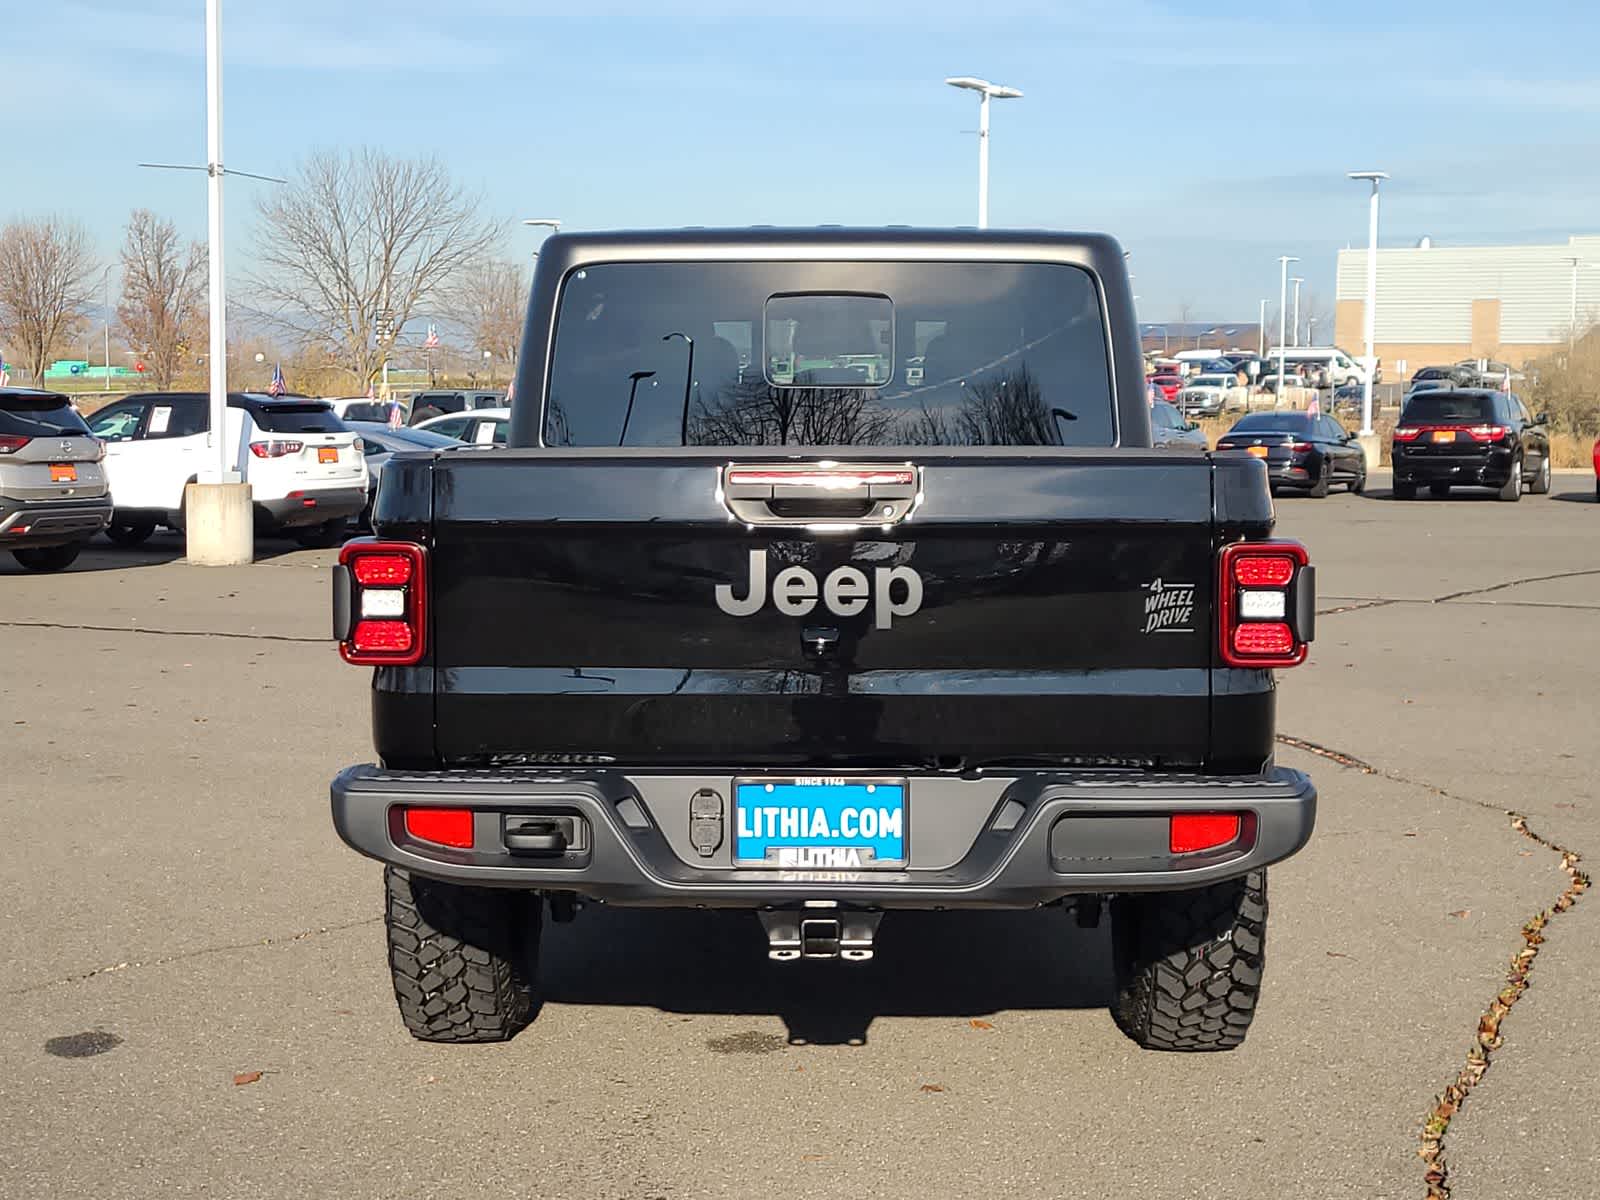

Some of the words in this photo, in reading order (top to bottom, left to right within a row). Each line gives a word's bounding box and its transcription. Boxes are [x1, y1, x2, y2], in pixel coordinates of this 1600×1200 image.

[715, 549, 923, 630] Jeep
[1149, 577, 1164, 593] 4
[1145, 590, 1194, 614] WHEEL
[1145, 607, 1193, 634] DRIVE
[737, 807, 903, 838] LITHIA.COM
[798, 848, 861, 867] LITHIA
